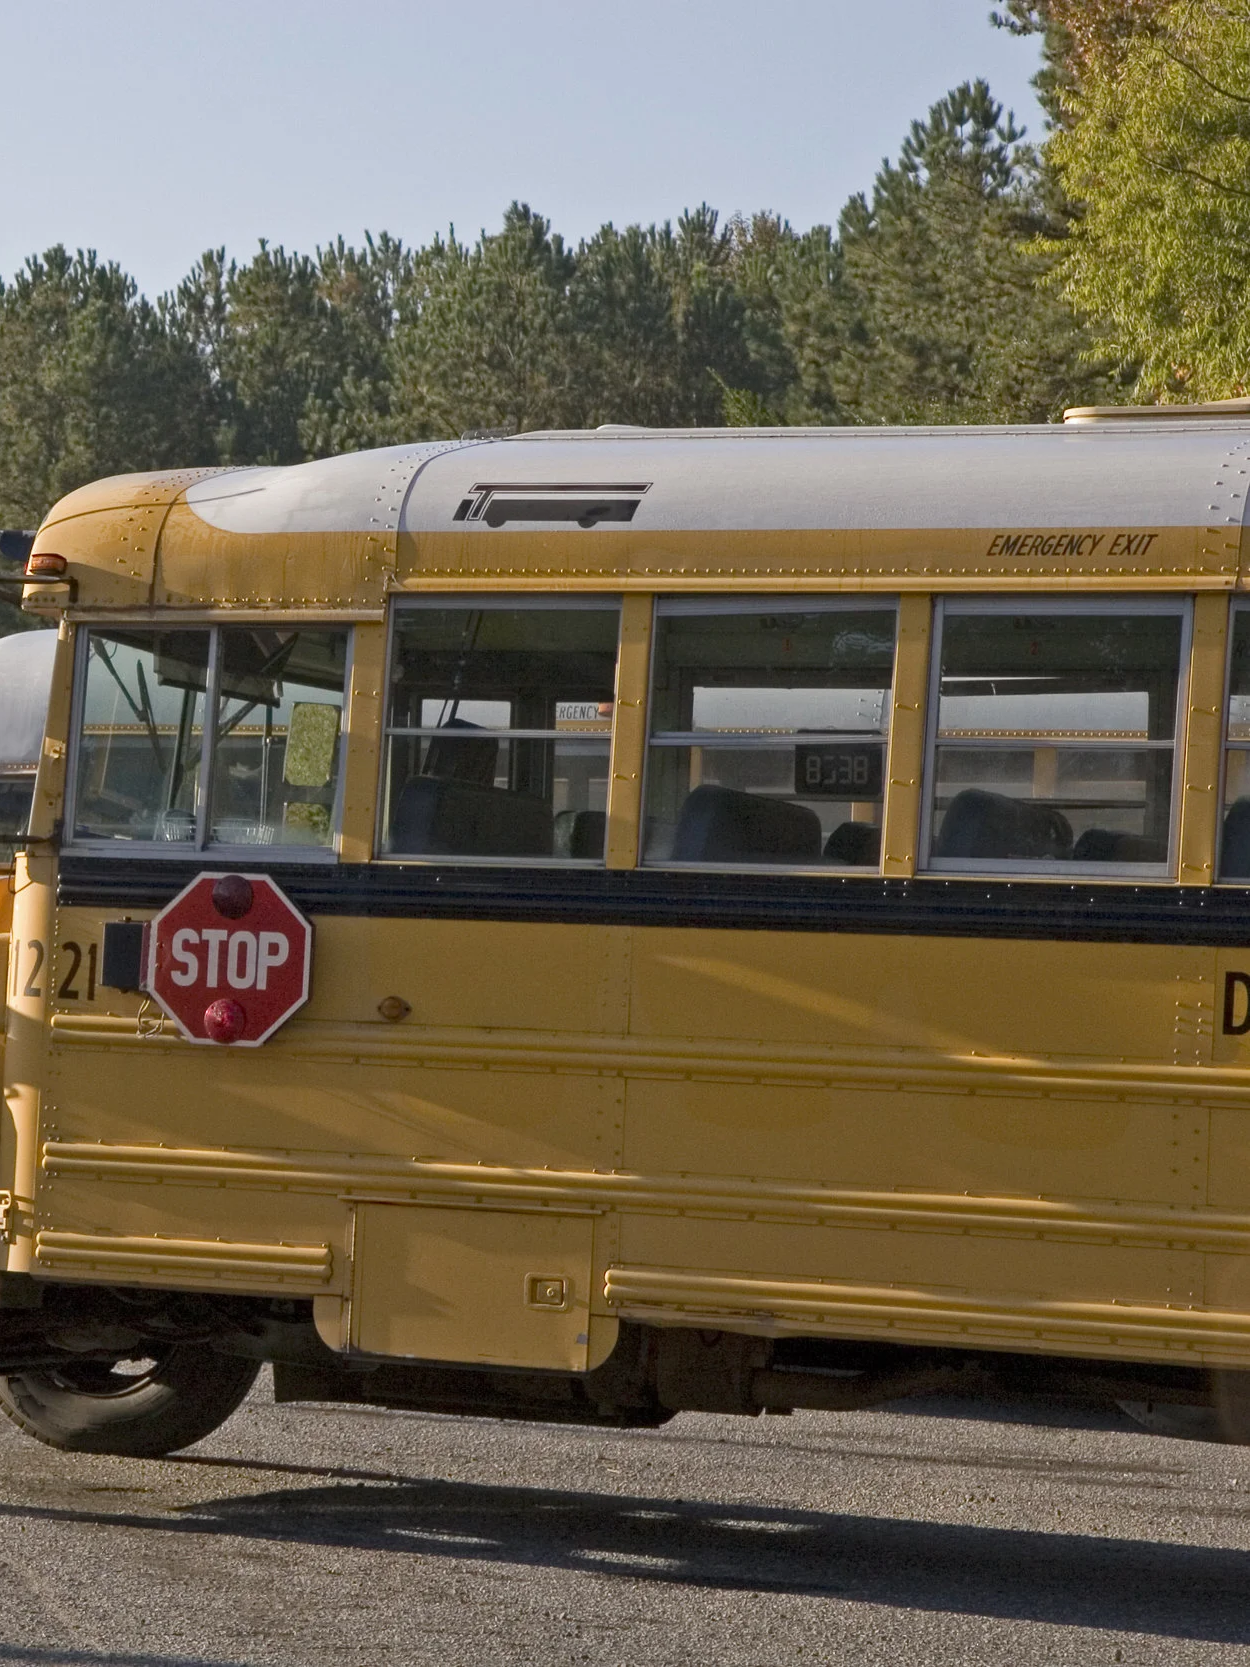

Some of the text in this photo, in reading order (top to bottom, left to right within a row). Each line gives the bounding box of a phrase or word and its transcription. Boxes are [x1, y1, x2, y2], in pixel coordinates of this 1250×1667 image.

[986, 534, 1159, 557] EMERGENCY EXIT
[171, 928, 289, 990] STOP
[1222, 971, 1250, 1035] D
